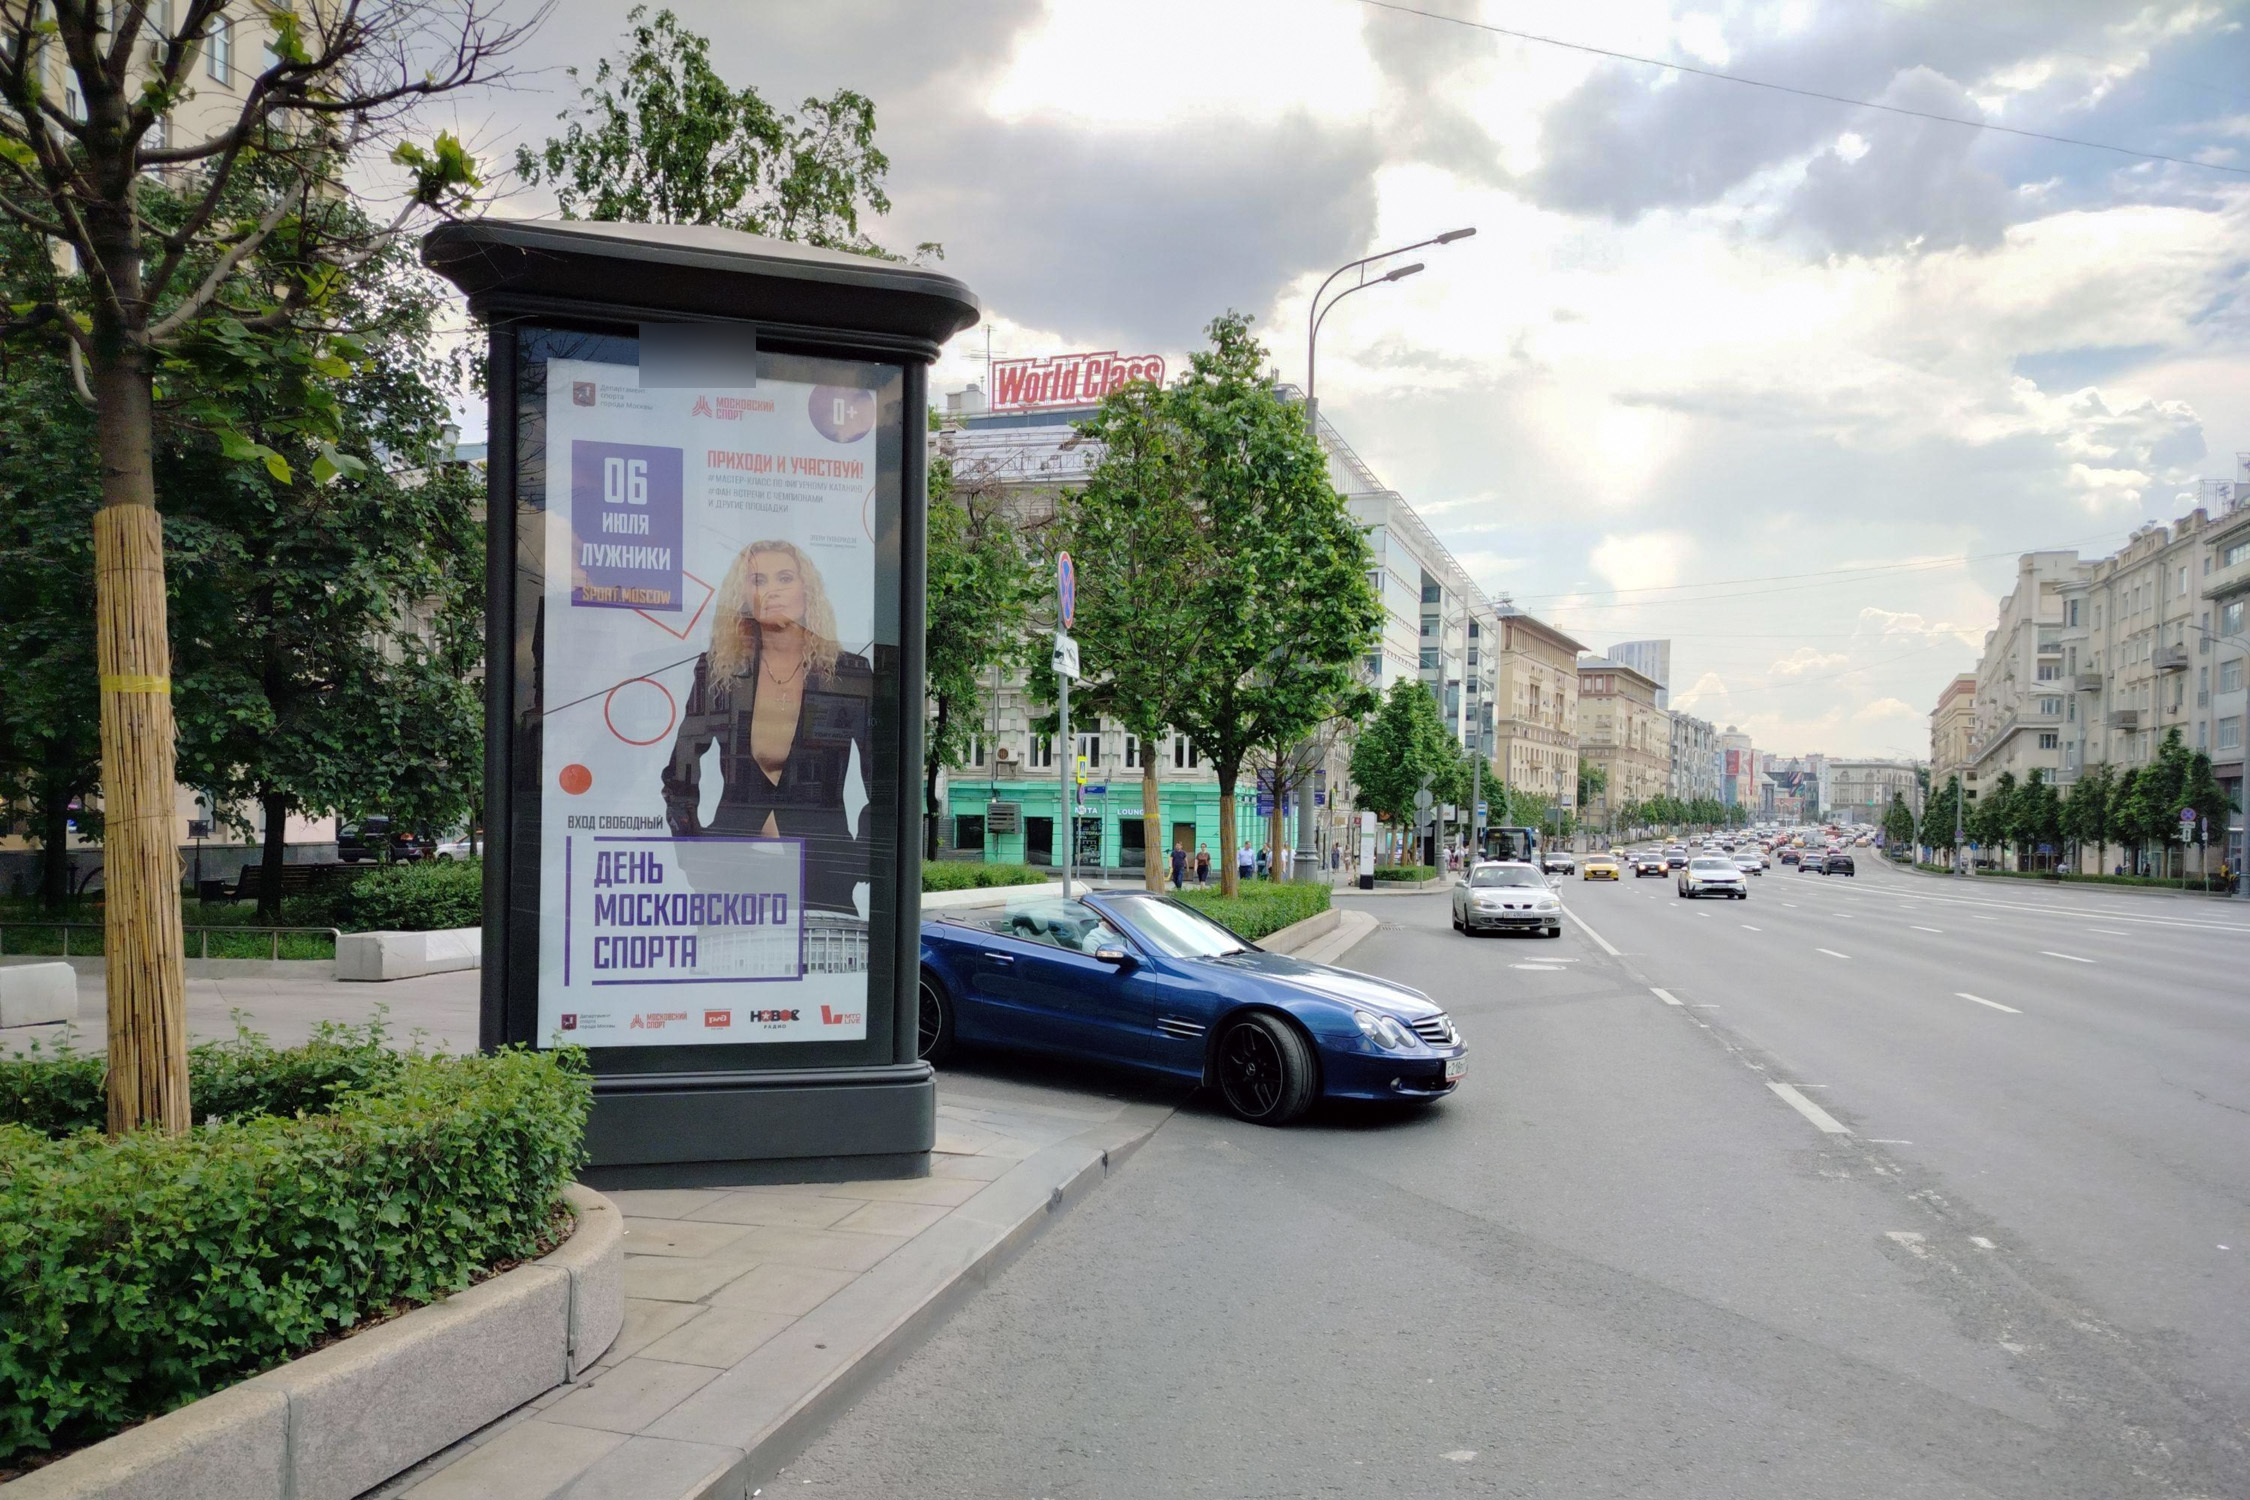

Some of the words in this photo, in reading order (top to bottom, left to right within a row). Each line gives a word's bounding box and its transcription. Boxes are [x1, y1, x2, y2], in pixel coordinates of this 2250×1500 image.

[1000, 362, 1080, 405] World
[1082, 358, 1161, 399] Class
[716, 397, 775, 412] МОСКОВСКИЙ
[716, 408, 744, 421] СПОРТ
[833, 398, 858, 426] 0+
[707, 450, 772, 474] ПРИХОДИ
[777, 456, 786, 473] И
[791, 456, 864, 479] УЧАСТВУЙ!
[604, 457, 648, 505] 06
[715, 500, 744, 511] ДРУГИЕ
[603, 512, 649, 535] ИЮЛЯ
[581, 543, 670, 571] ЛУЖНИКИ
[582, 586, 671, 605] SPORT.MOSCOW
[568, 815, 596, 831] ВХОД
[599, 814, 664, 831] СВОБОДНЫЙ
[594, 851, 663, 888] ДЕНЬ
[594, 893, 787, 927] МОСКОВСКОГО
[594, 935, 697, 969] СПОРТА
[647, 1021, 666, 1029] СПОРТ
